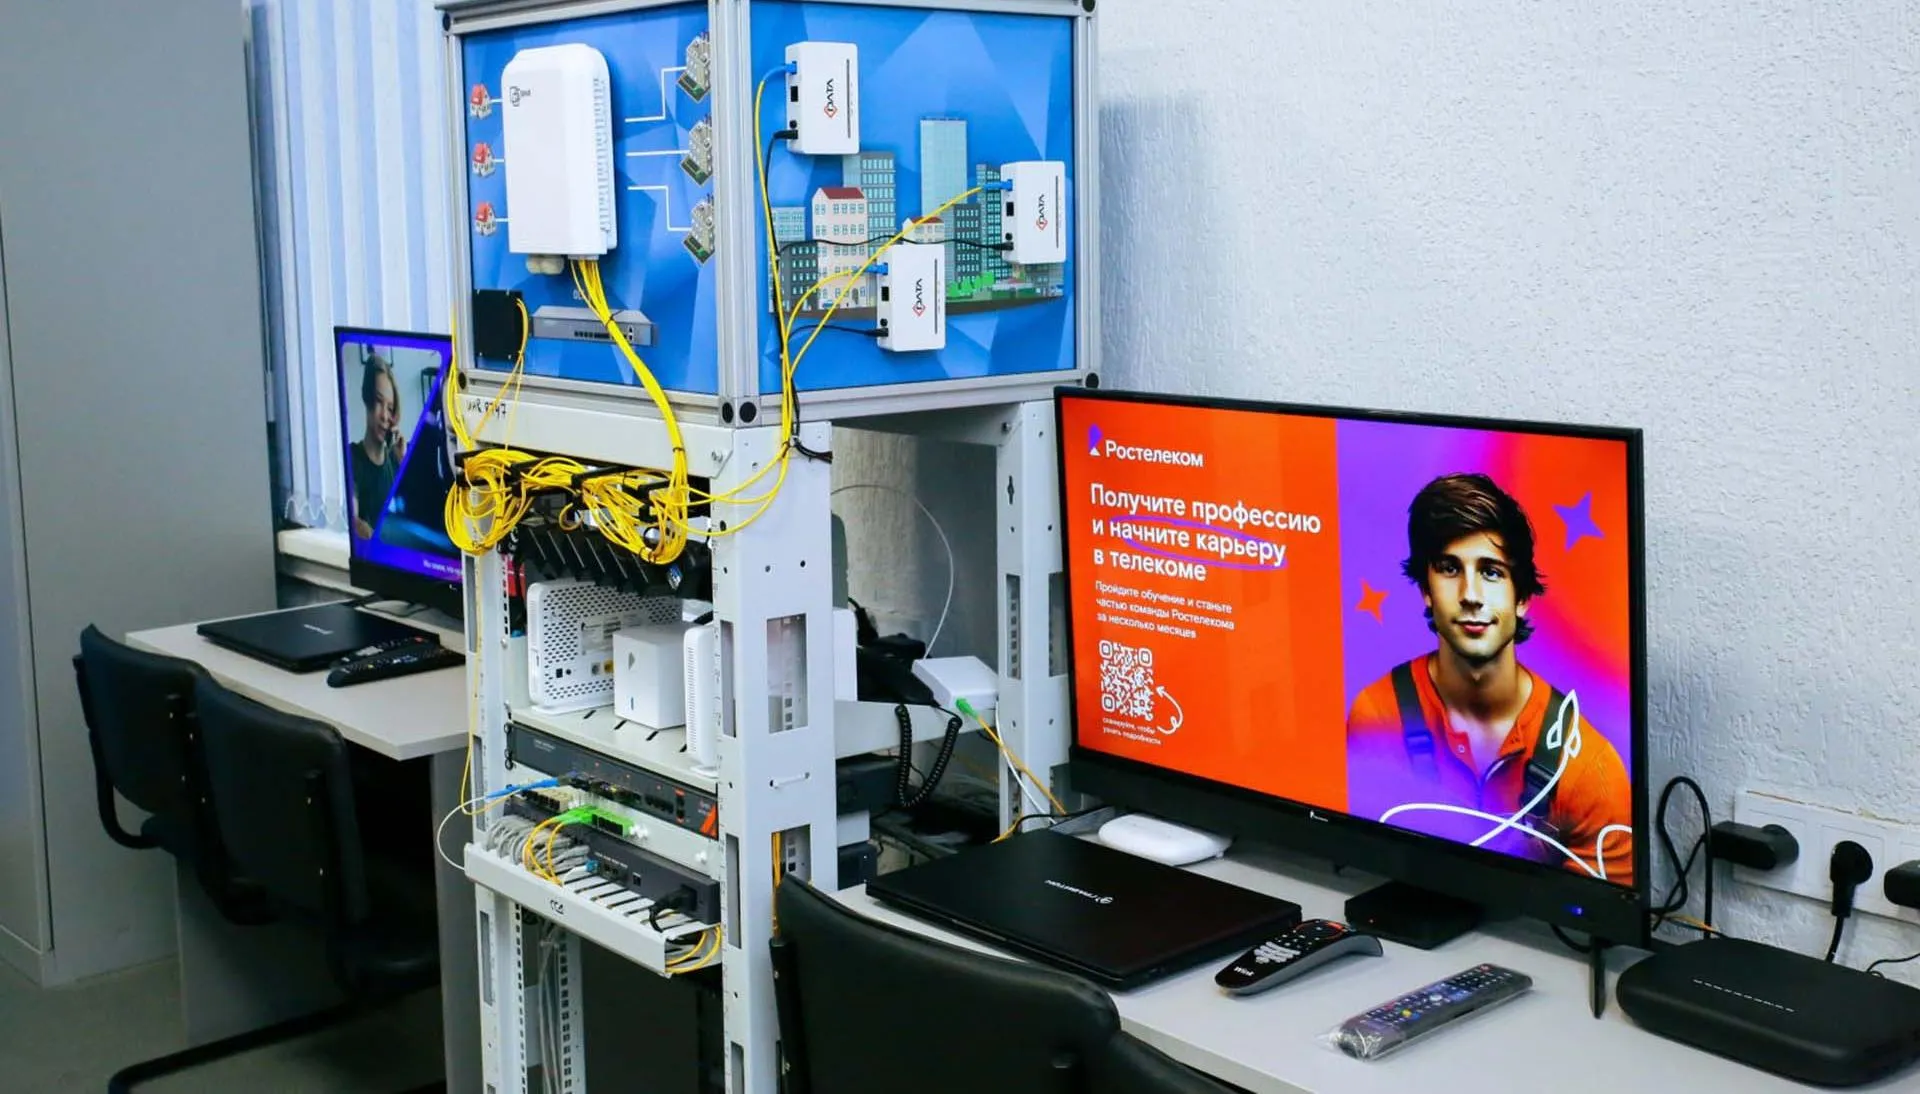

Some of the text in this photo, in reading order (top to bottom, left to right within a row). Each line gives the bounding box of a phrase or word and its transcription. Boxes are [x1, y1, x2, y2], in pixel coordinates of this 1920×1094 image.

[1105, 439, 1204, 467] Ростелеком
[1091, 483, 1321, 534] Получите профессию
[1092, 519, 1287, 567] и начните карьеру
[1093, 549, 1207, 581] в телекоме
[1095, 580, 1233, 614] Пройдите обучение и станьте
[1096, 598, 1235, 630] частью команды Ростелекома
[1097, 612, 1197, 639] за несколько месяцев
